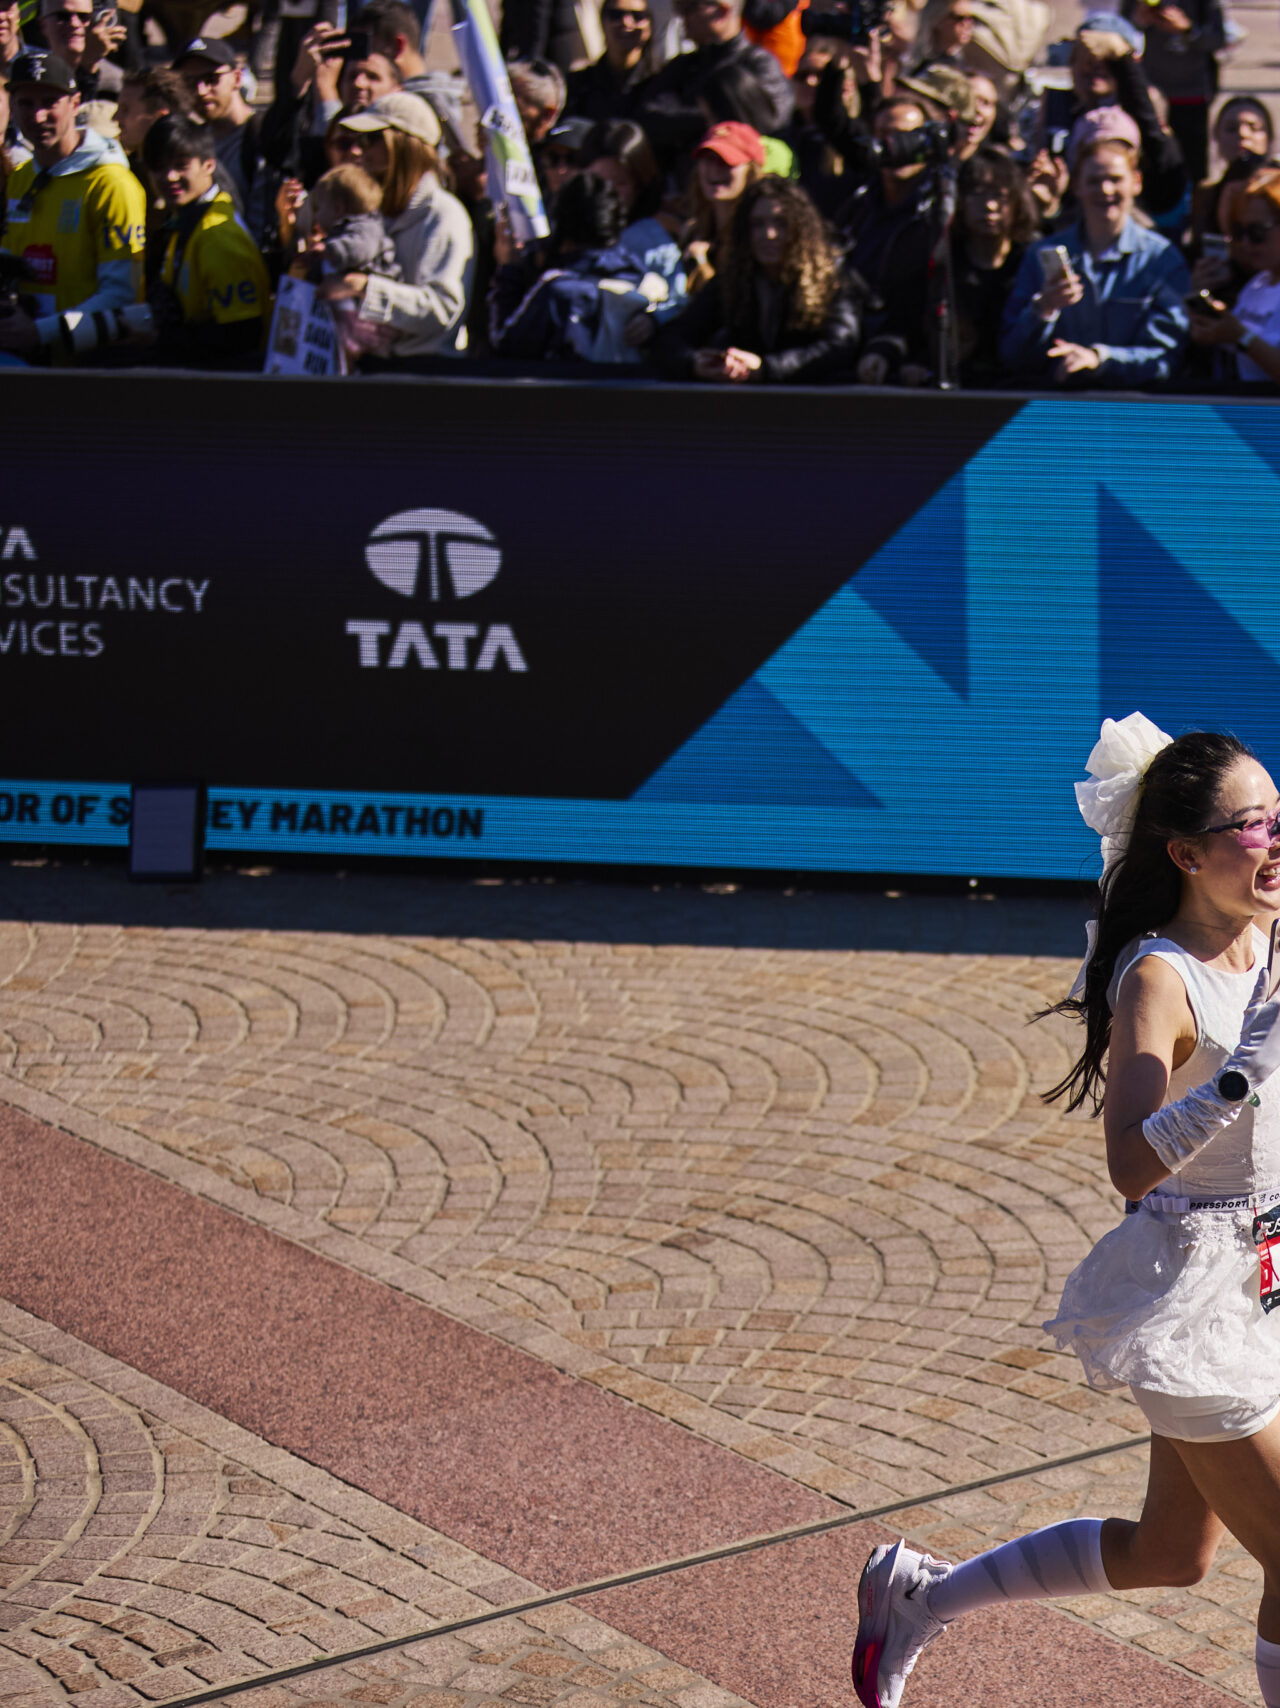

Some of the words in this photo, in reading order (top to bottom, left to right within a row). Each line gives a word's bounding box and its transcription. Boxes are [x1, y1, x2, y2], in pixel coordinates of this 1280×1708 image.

[346, 618, 528, 672] TATA
[52, 794, 101, 825] OF
[269, 801, 485, 839] MARATHON
